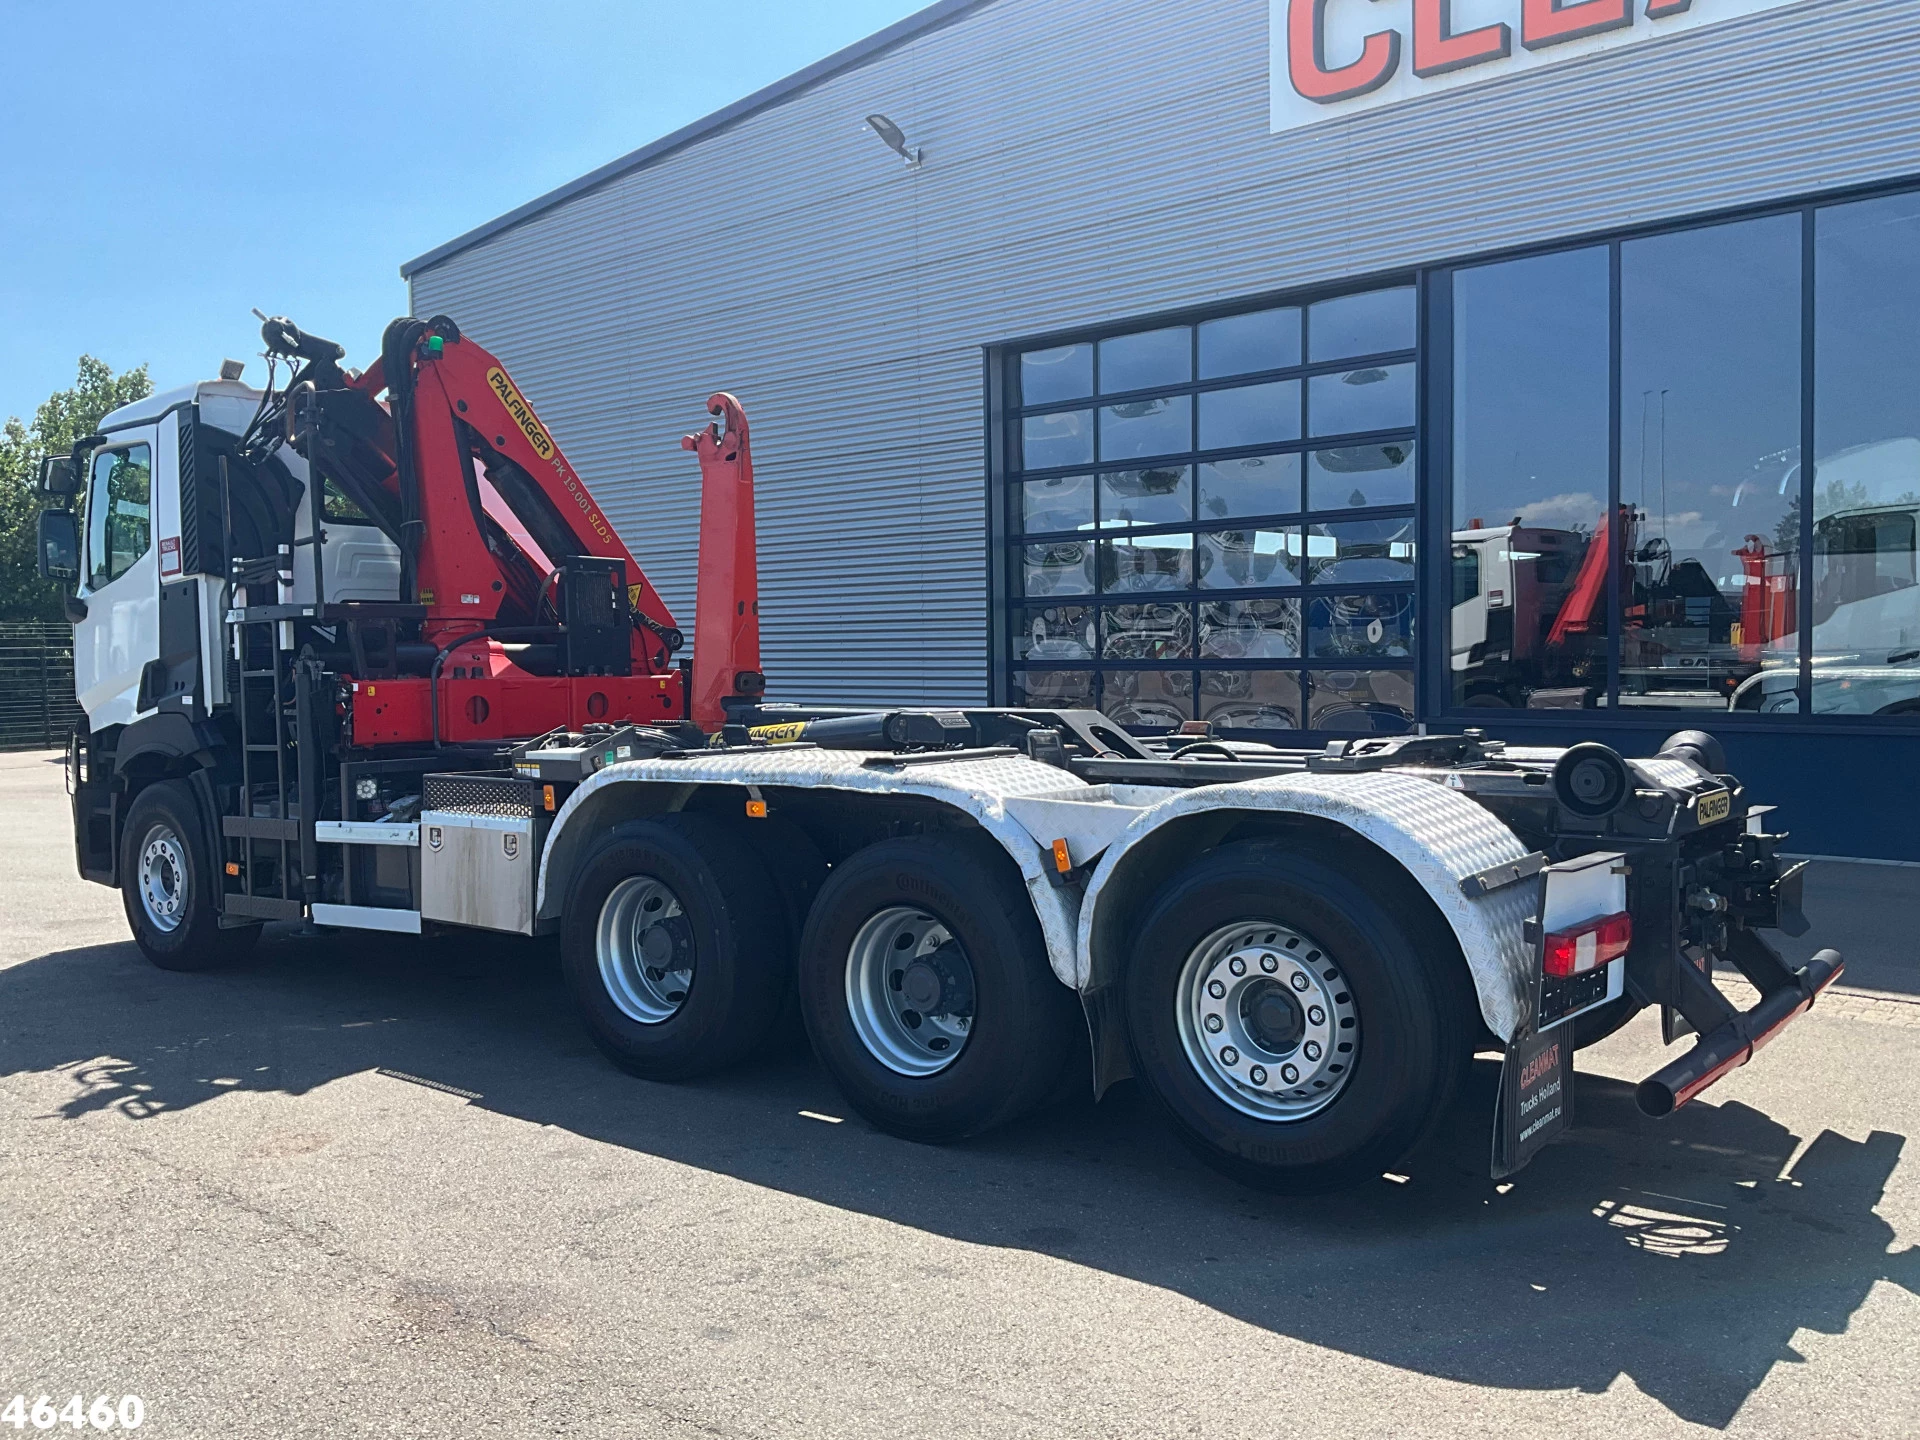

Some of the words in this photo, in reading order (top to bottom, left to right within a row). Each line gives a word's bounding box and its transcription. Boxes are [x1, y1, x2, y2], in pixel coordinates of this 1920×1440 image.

[490, 372, 551, 455] PALFINGER
[551, 457, 565, 478] PK
[564, 477, 592, 515] 19.001
[1700, 796, 1728, 820] PALFINGER
[1520, 1044, 1559, 1091] CLEANMAT
[1520, 1094, 1539, 1117] Trucks
[1539, 1076, 1561, 1102] Holland
[1519, 1106, 1561, 1142] www.cleanmat.eu
